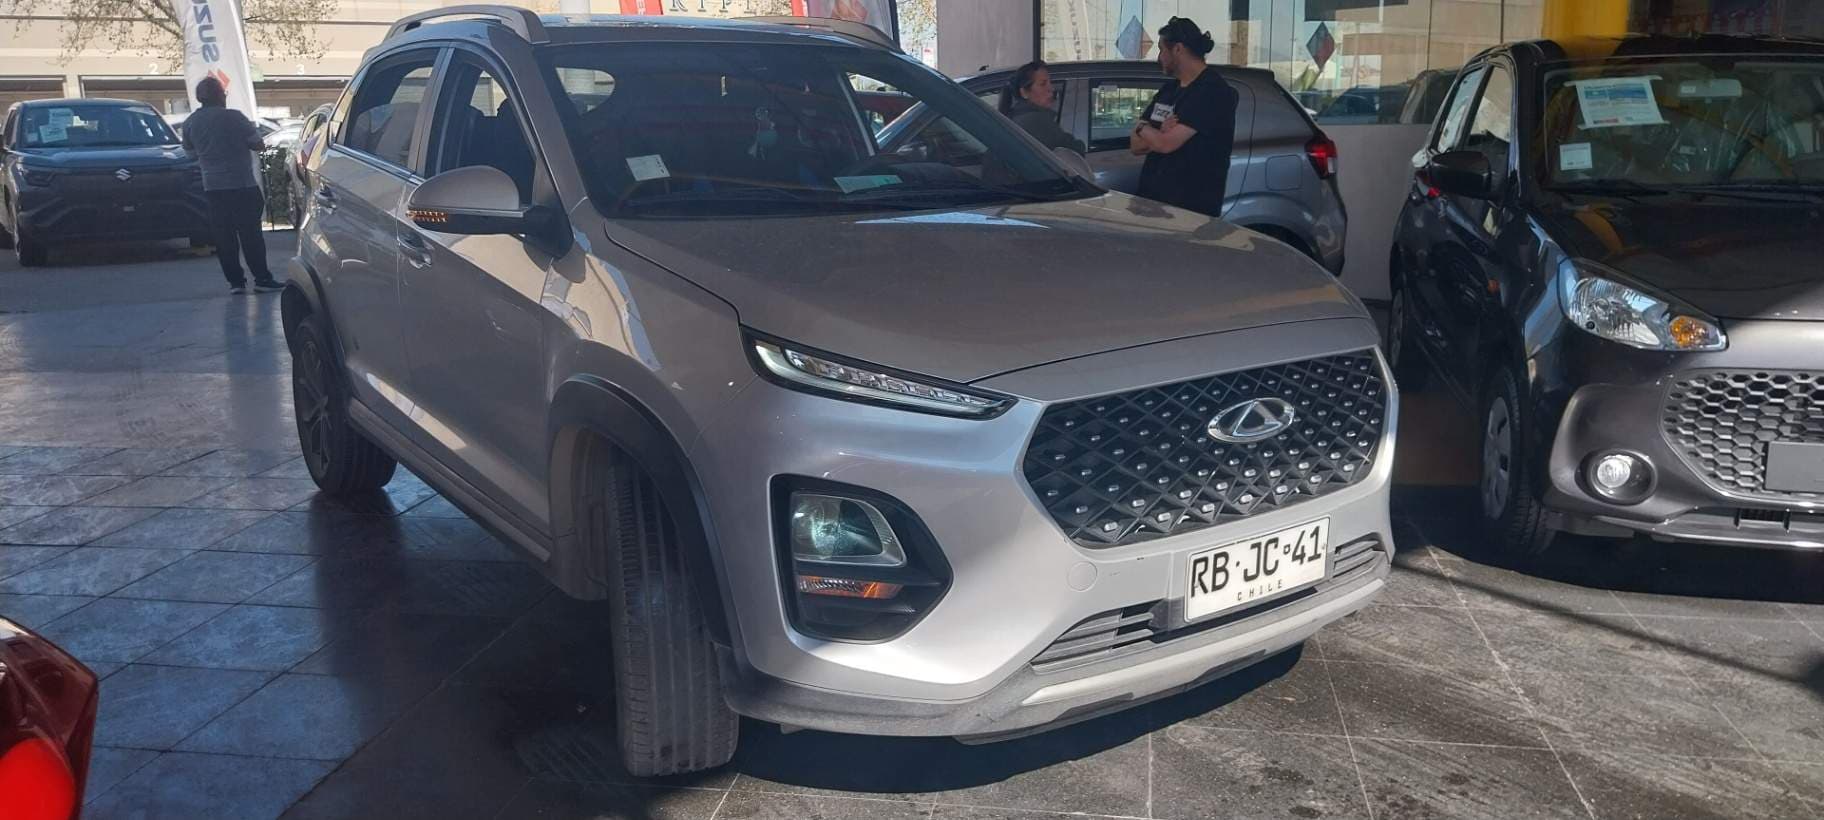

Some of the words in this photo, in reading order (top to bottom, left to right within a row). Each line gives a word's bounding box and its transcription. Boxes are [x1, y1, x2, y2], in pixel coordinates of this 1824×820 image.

[148, 64, 158, 75] 2
[296, 64, 304, 75] 3
[1237, 579, 1283, 601] CHILE
